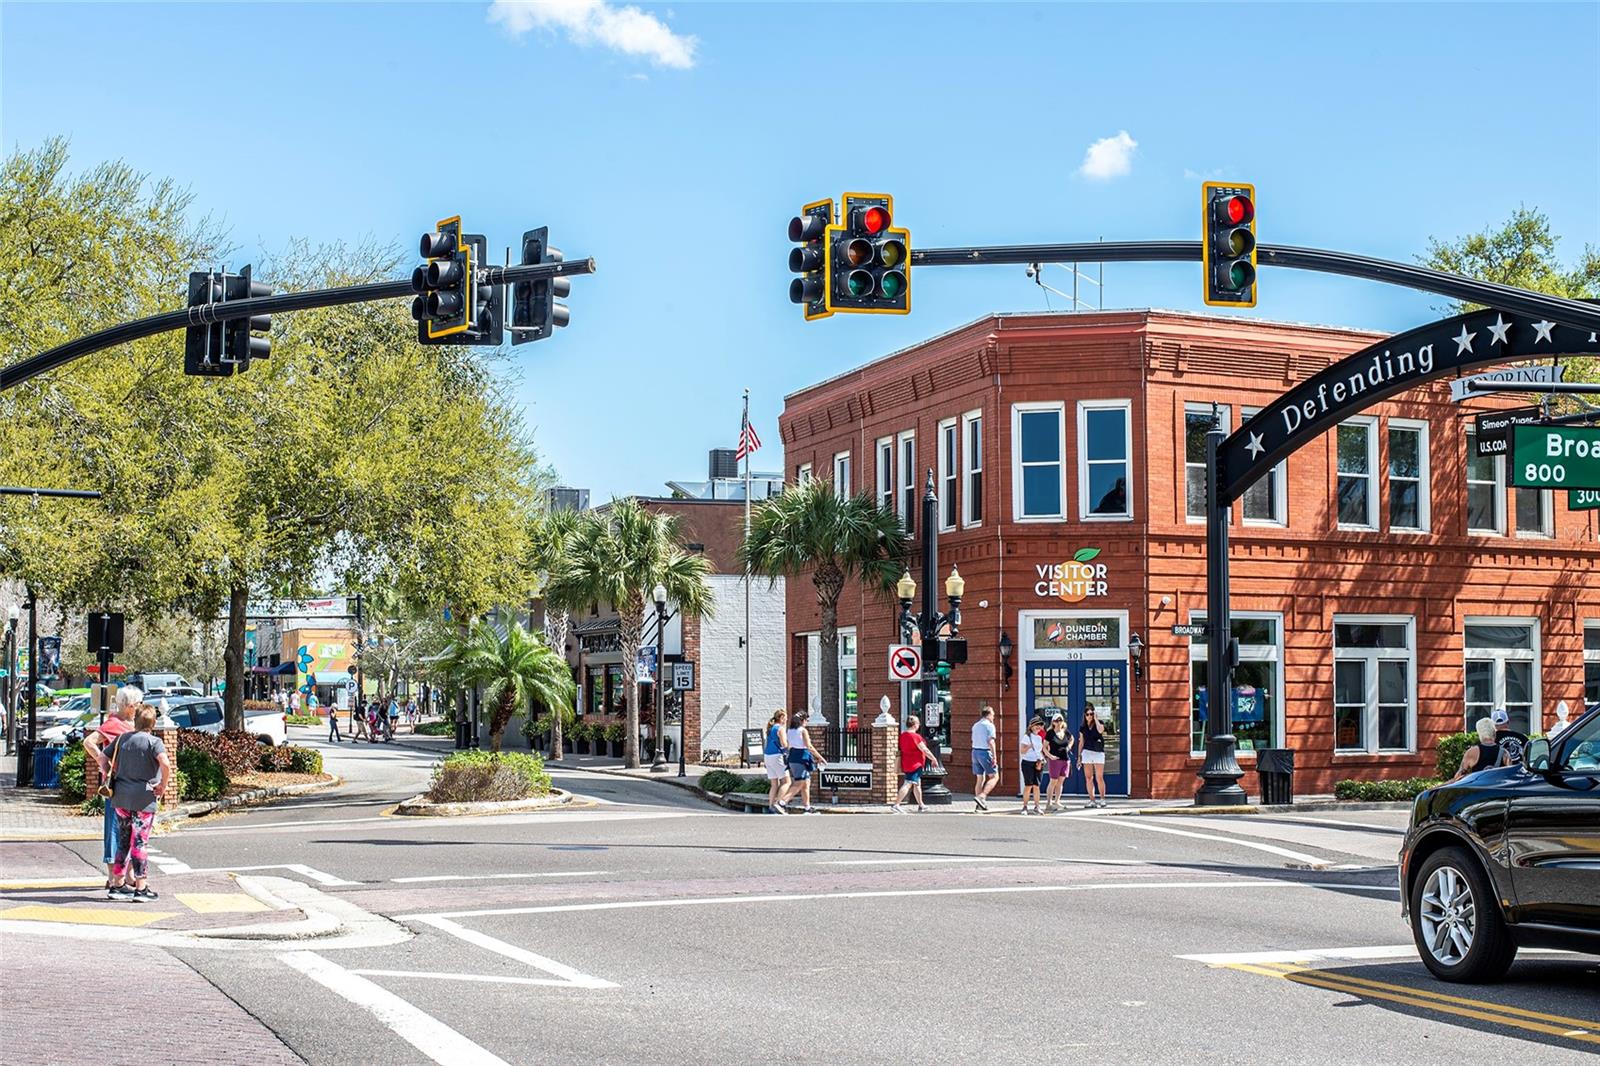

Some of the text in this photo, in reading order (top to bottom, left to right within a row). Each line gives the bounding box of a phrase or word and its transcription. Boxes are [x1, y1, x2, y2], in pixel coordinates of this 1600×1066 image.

[1462, 369, 1545, 395] HORING
[1280, 343, 1434, 435] Defending
[1482, 420, 1509, 430] Simeon
[1547, 434, 1600, 457] Broa
[1525, 464, 1566, 482] 800
[1035, 564, 1107, 579] VISITOR
[1035, 581, 1108, 596] CENTER
[1065, 623, 1108, 633] DUNEDIN
[1174, 626, 1205, 635] BROADWAY
[1065, 633, 1108, 641] CHAMBER
[348, 681, 355, 690] P
[676, 676, 690, 687] 15
[824, 774, 868, 783] WELCOME
